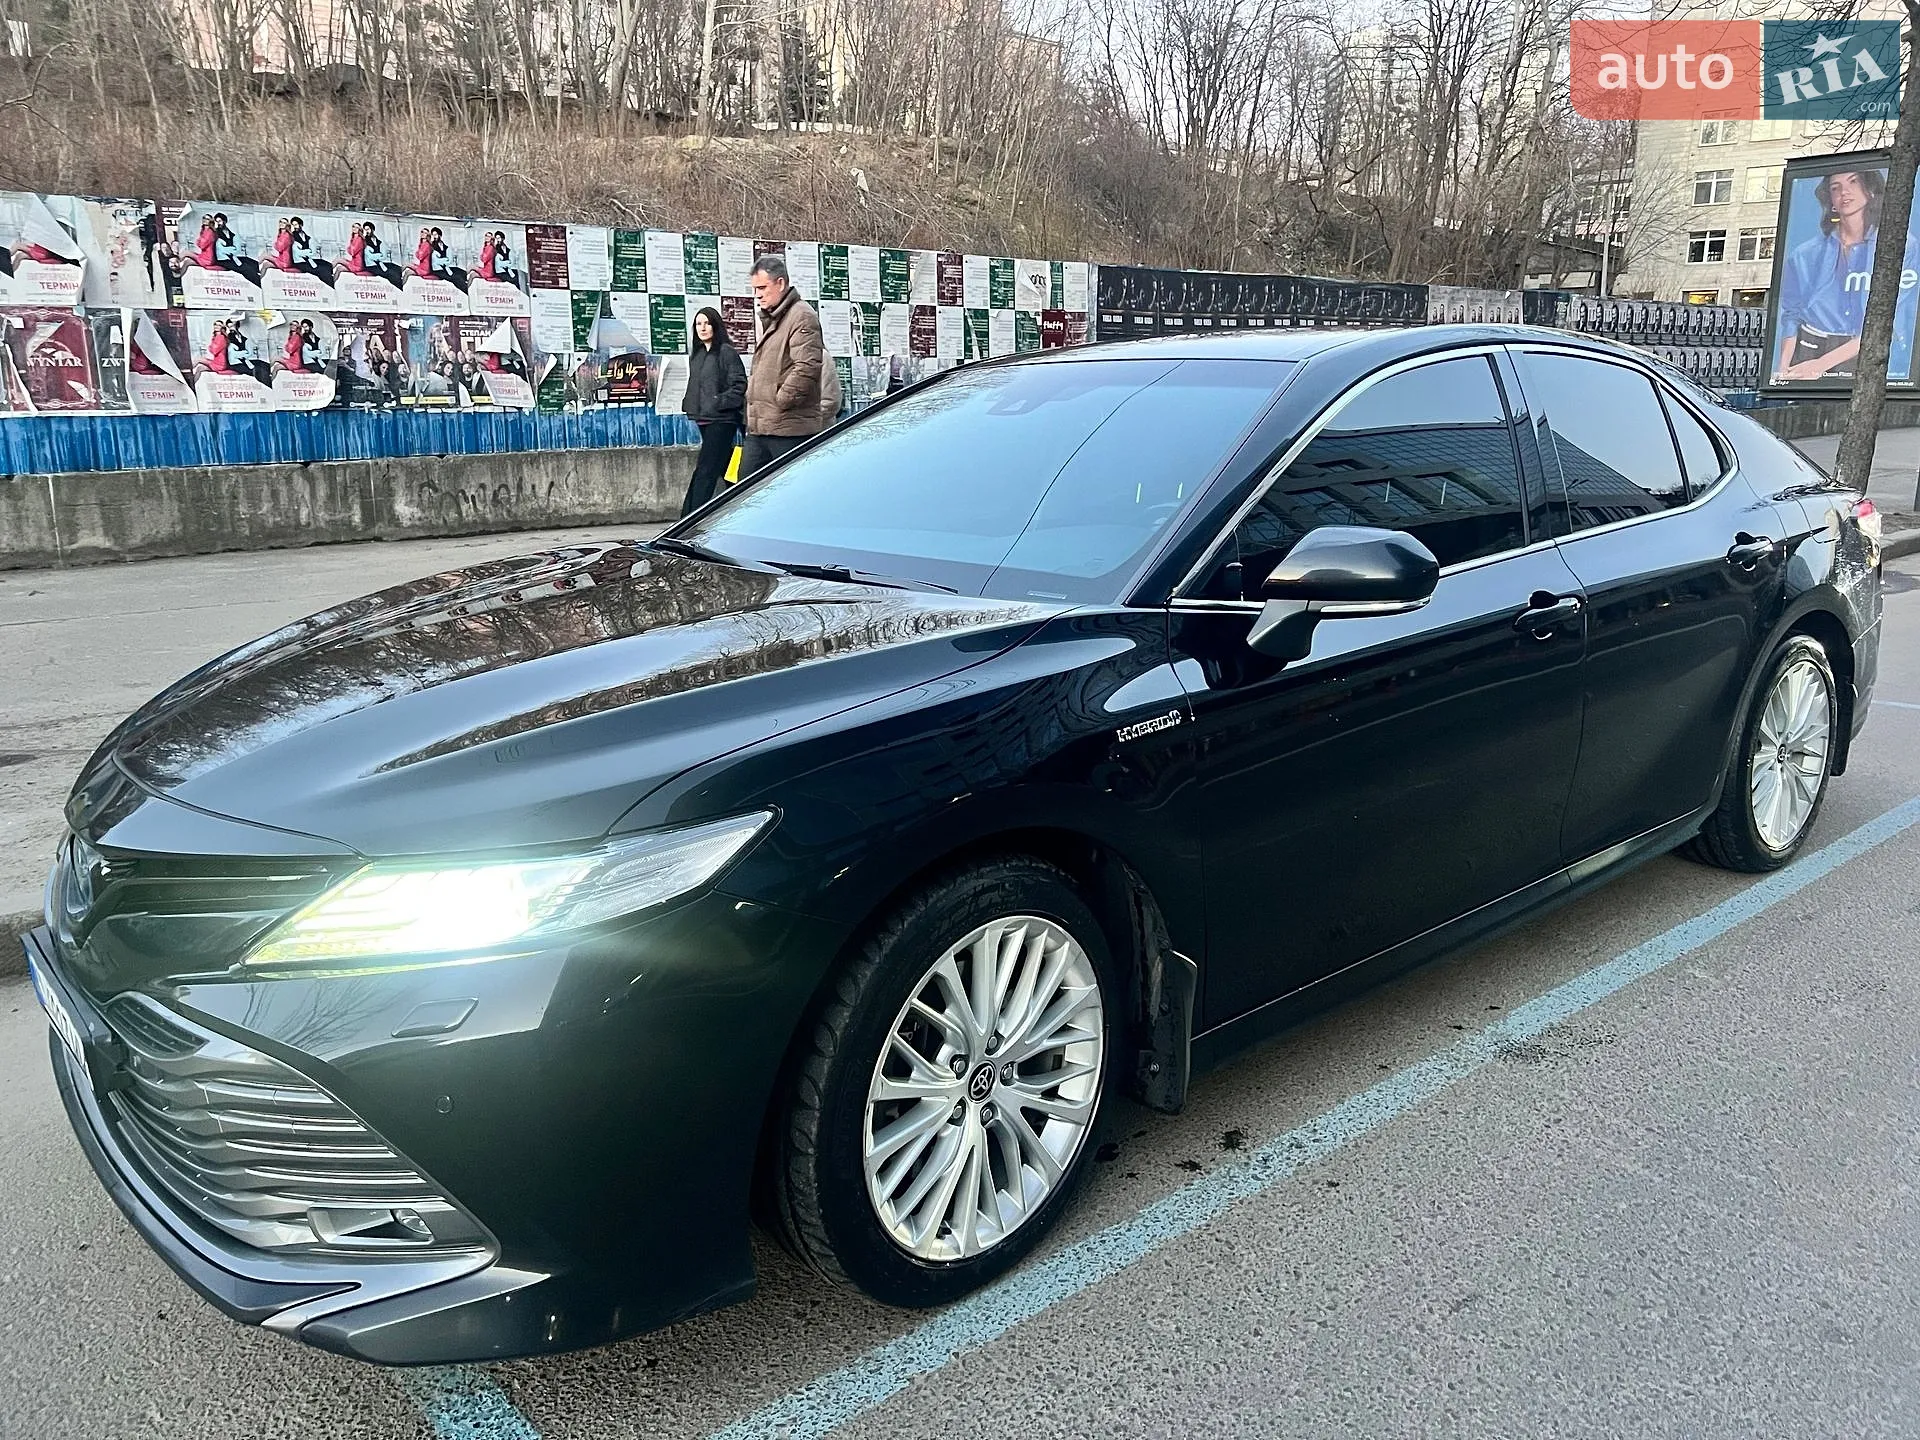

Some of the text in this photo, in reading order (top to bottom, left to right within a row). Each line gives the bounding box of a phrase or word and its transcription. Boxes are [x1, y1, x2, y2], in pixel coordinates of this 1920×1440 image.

[40, 281, 79, 290] ТЕРМІН
[204, 286, 241, 296] ТЕРМІН
[282, 288, 316, 297] ТЕРМІН
[354, 291, 387, 300] ТЕРМІН
[421, 294, 452, 303] ТЕРМІН
[485, 296, 514, 305] ТЕРМІН
[27, 357, 84, 367] WYNTAR
[140, 391, 176, 400] ТЕРМІН
[217, 390, 254, 399] ТЕРМІН
[292, 388, 325, 397] ТЕРМІН
